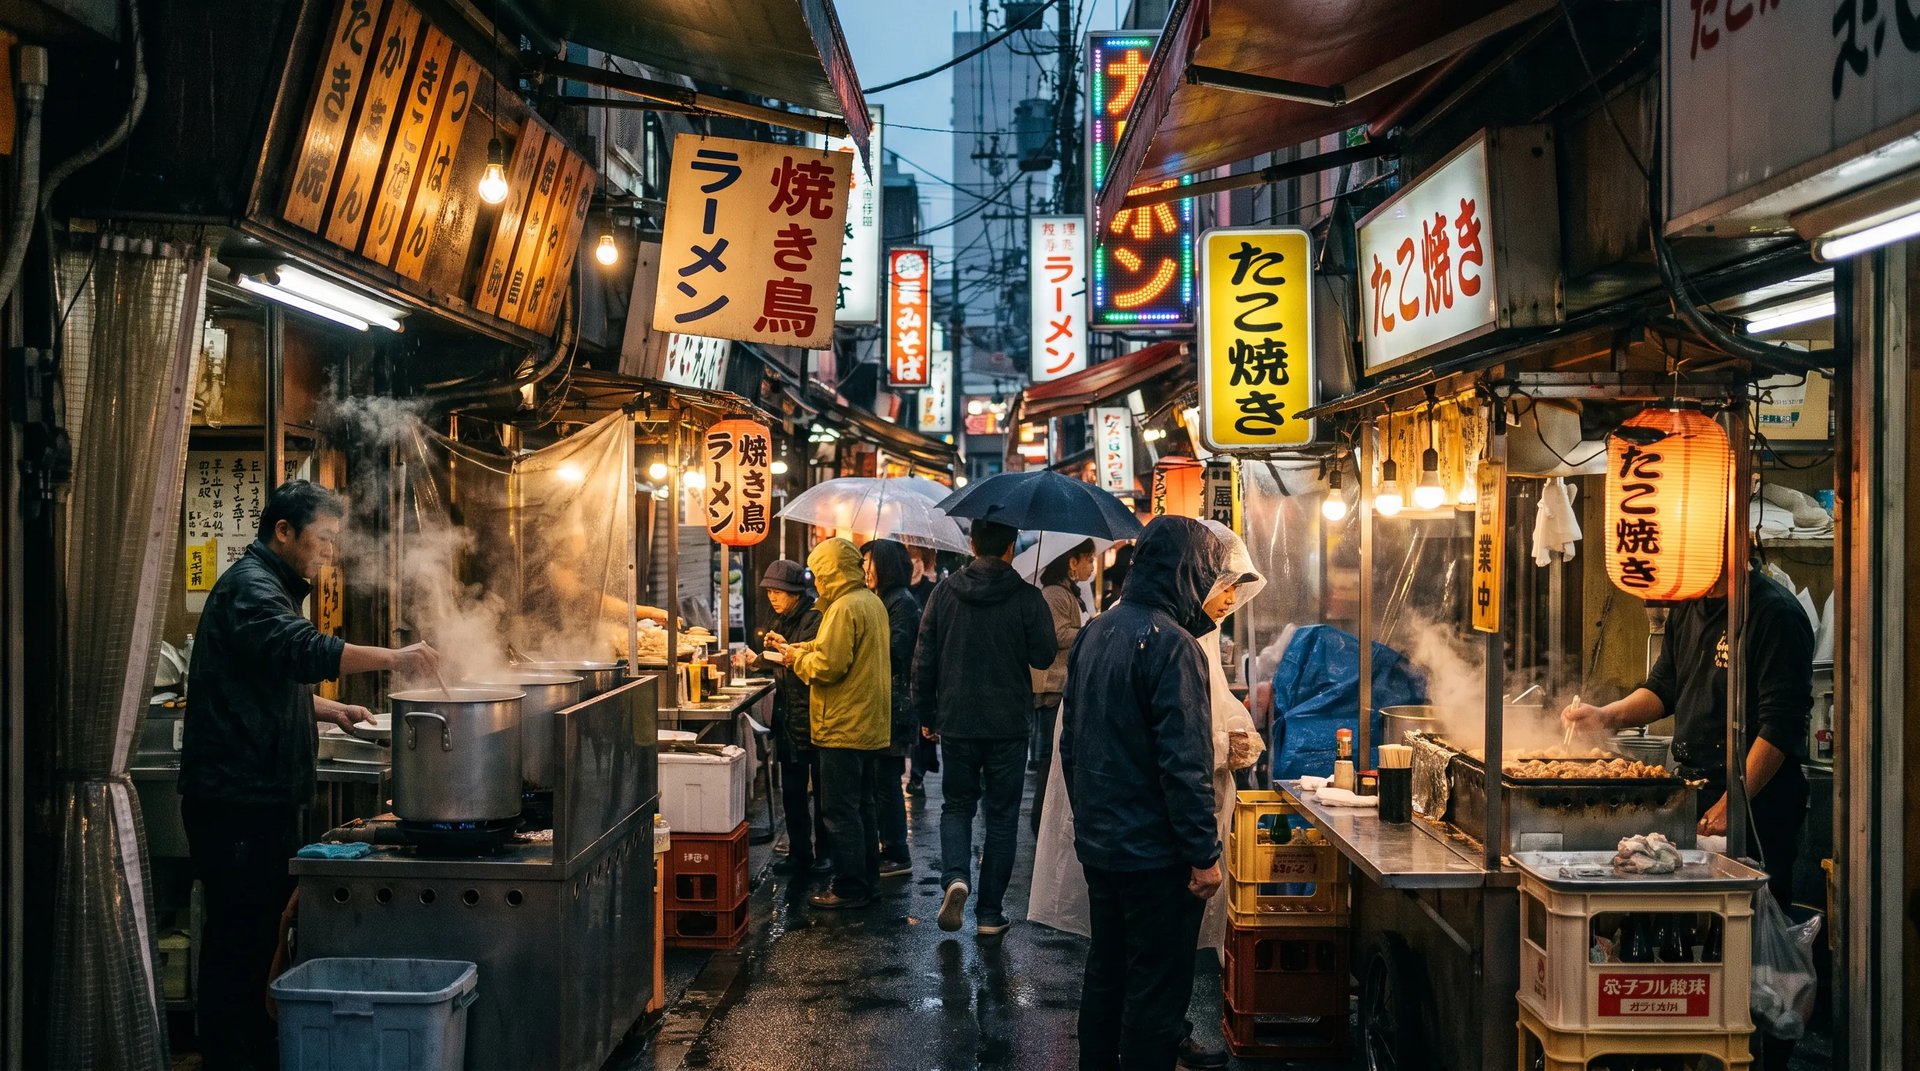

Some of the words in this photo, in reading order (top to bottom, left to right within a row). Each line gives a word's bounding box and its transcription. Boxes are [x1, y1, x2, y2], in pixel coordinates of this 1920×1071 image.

[674, 149, 742, 323] ラーメン
[753, 156, 835, 338] 焼き鳥
[1371, 198, 1483, 337] たこ焼き
[1044, 256, 1075, 374] ラーメン
[1228, 241, 1290, 435] たこ焼き
[707, 432, 734, 534] ラーメン
[738, 434, 767, 534] 焼き鳥
[1477, 481, 1494, 616] 営業中
[1617, 446, 1661, 588] たこ焼き
